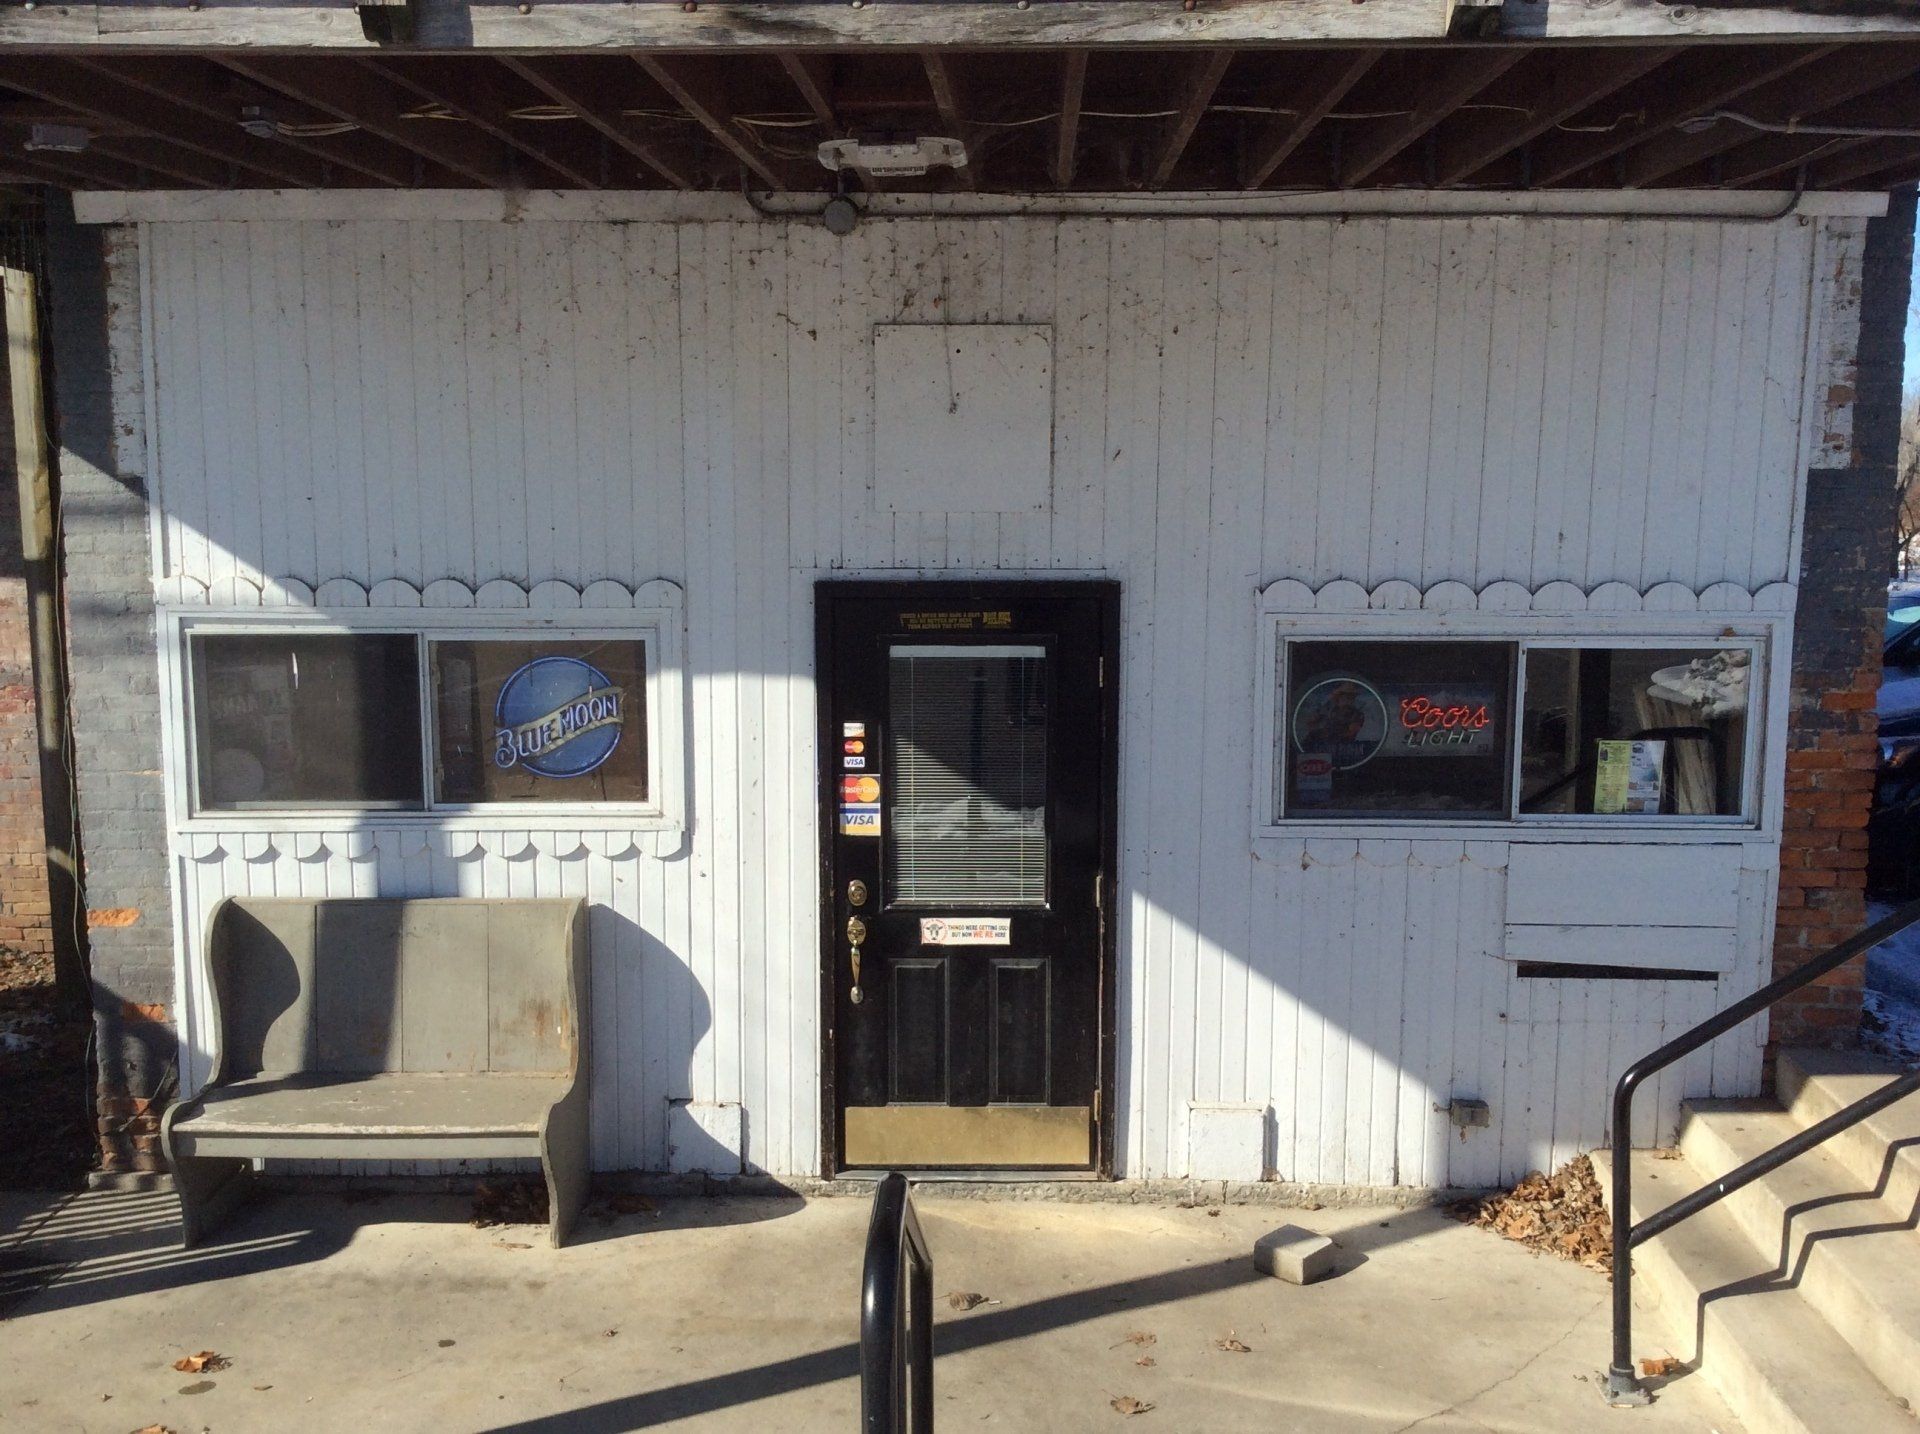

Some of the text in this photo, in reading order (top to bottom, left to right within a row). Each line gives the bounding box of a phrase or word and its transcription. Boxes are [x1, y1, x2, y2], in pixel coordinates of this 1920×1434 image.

[1400, 696, 1490, 728] Coors
[494, 693, 618, 769] BLUE MOON
[1406, 729, 1482, 748] LIGHT
[846, 758, 864, 766] VISA
[840, 785, 880, 794] MasterCard
[845, 815, 874, 825] VISA
